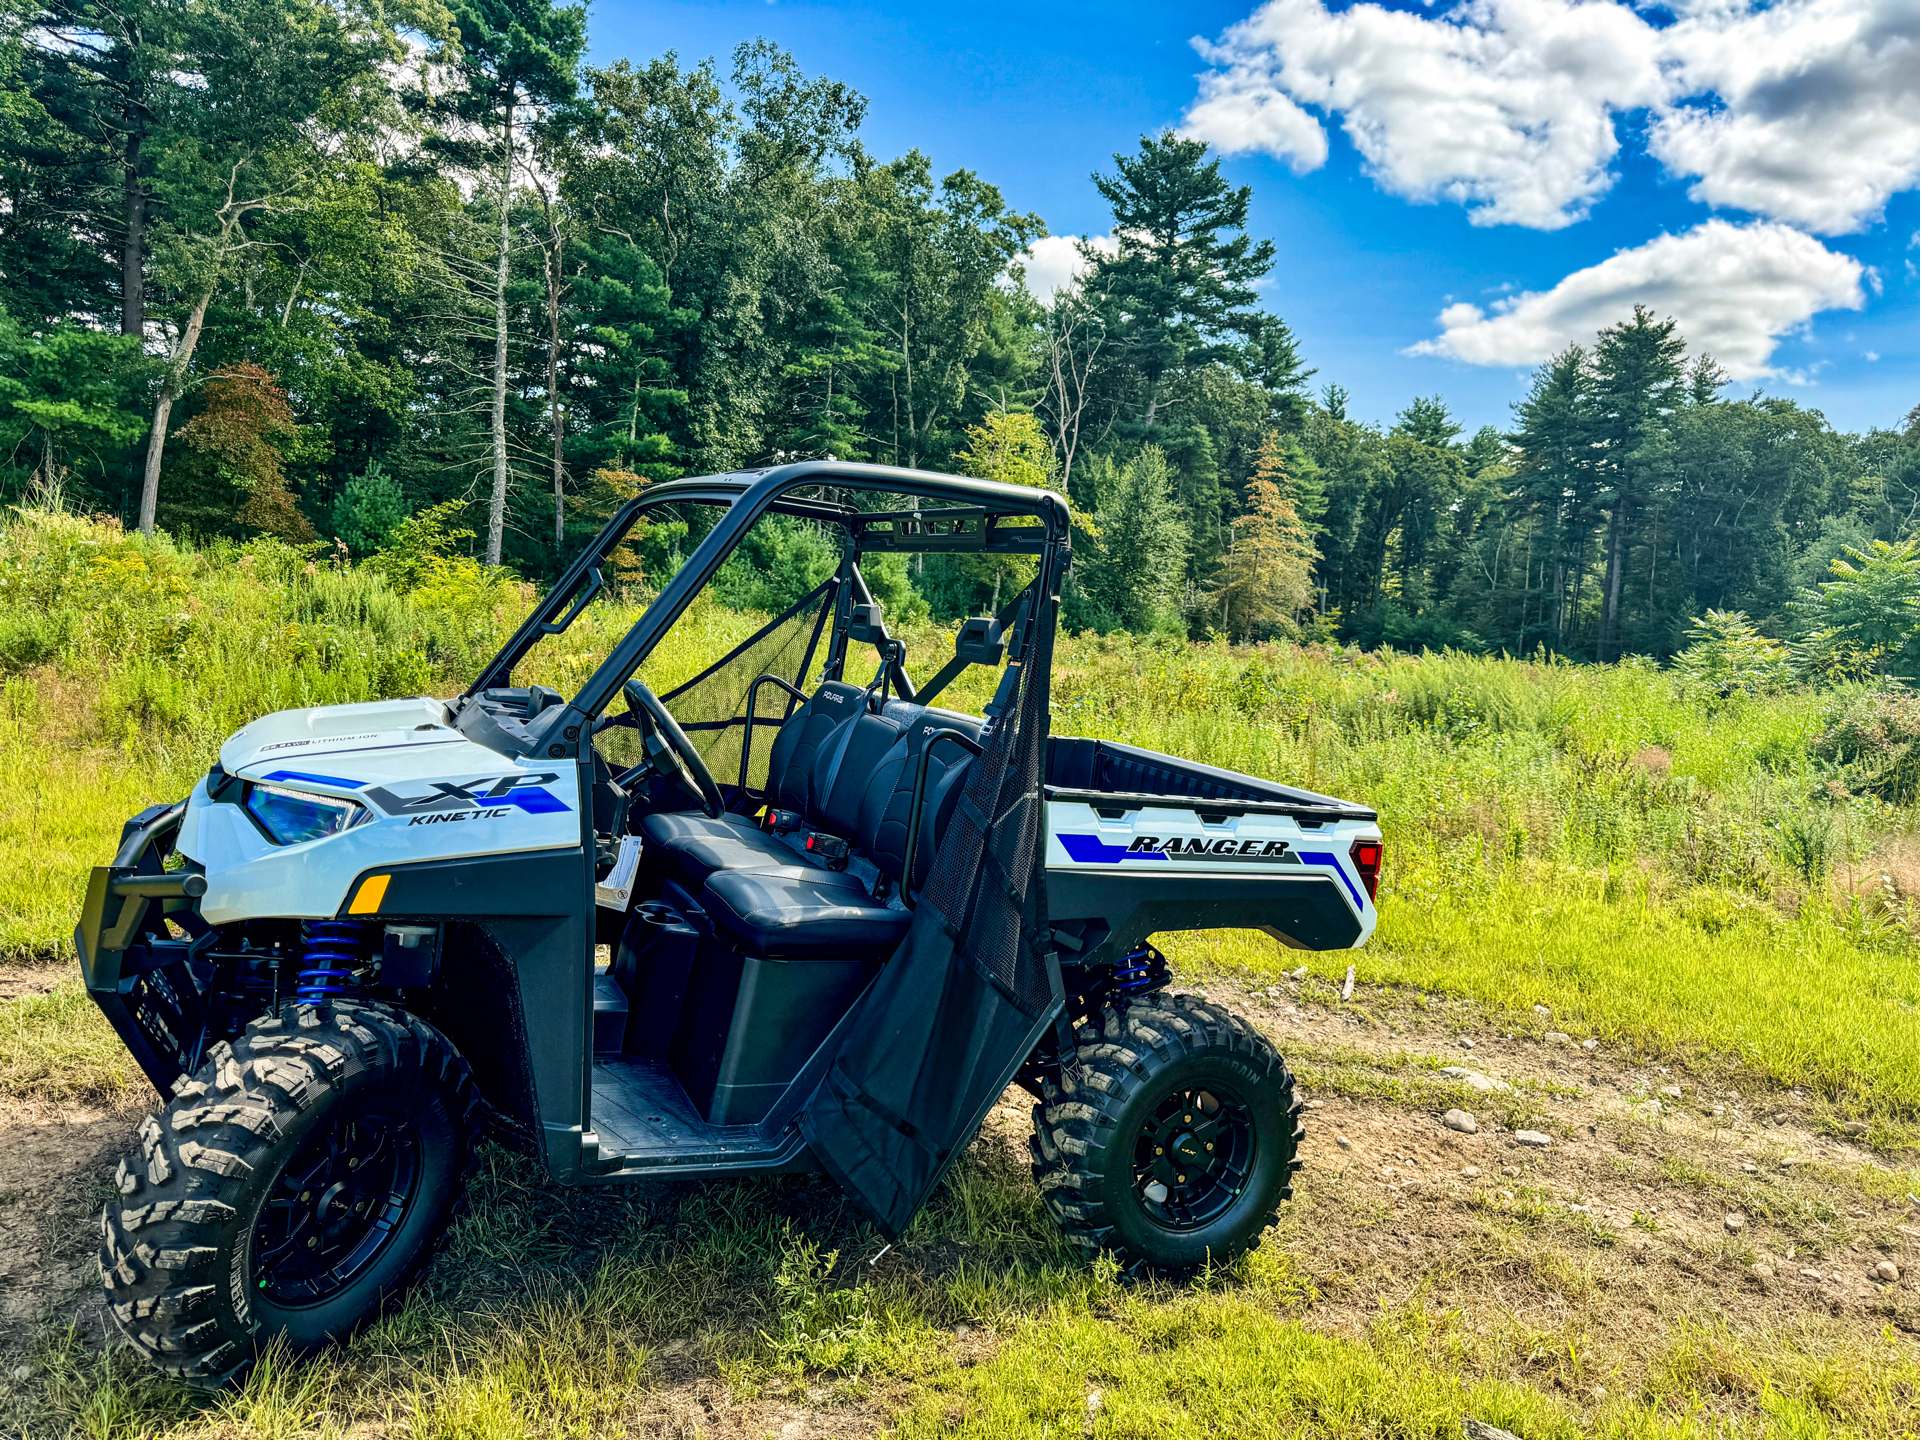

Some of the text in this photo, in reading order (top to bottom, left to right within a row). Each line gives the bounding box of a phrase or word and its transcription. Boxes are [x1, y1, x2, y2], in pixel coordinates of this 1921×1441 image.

[823, 690, 844, 704] POLARIS
[312, 736, 355, 744] LITHIUM
[402, 773, 560, 806] XP
[407, 808, 512, 827] KINETIC
[1127, 836, 1290, 857] RANGER
